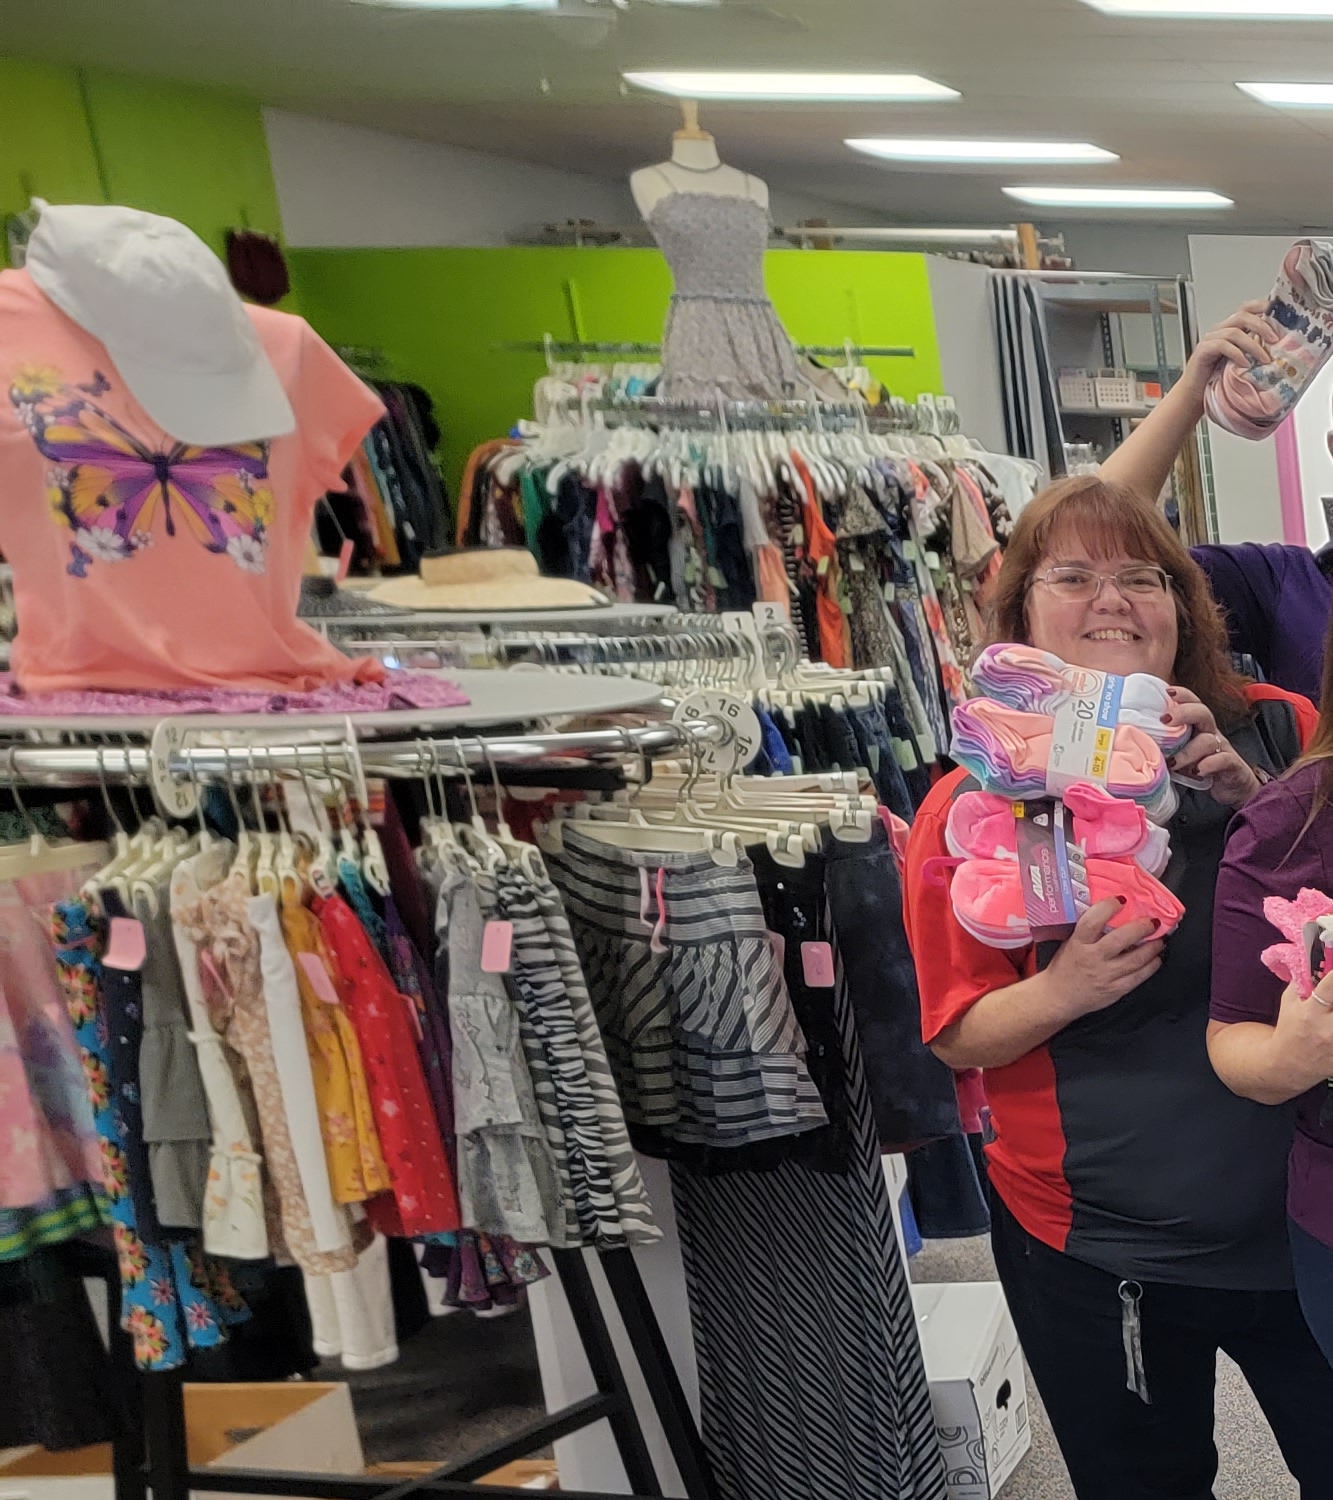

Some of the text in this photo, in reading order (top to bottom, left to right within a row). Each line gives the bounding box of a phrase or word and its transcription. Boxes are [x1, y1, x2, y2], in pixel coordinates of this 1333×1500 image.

[733, 616, 743, 630] 1
[764, 607, 775, 620] 2
[718, 698, 742, 718] 16
[1076, 699, 1096, 721] 20
[1029, 864, 1046, 902] AVIA
[1041, 848, 1060, 913] performance
